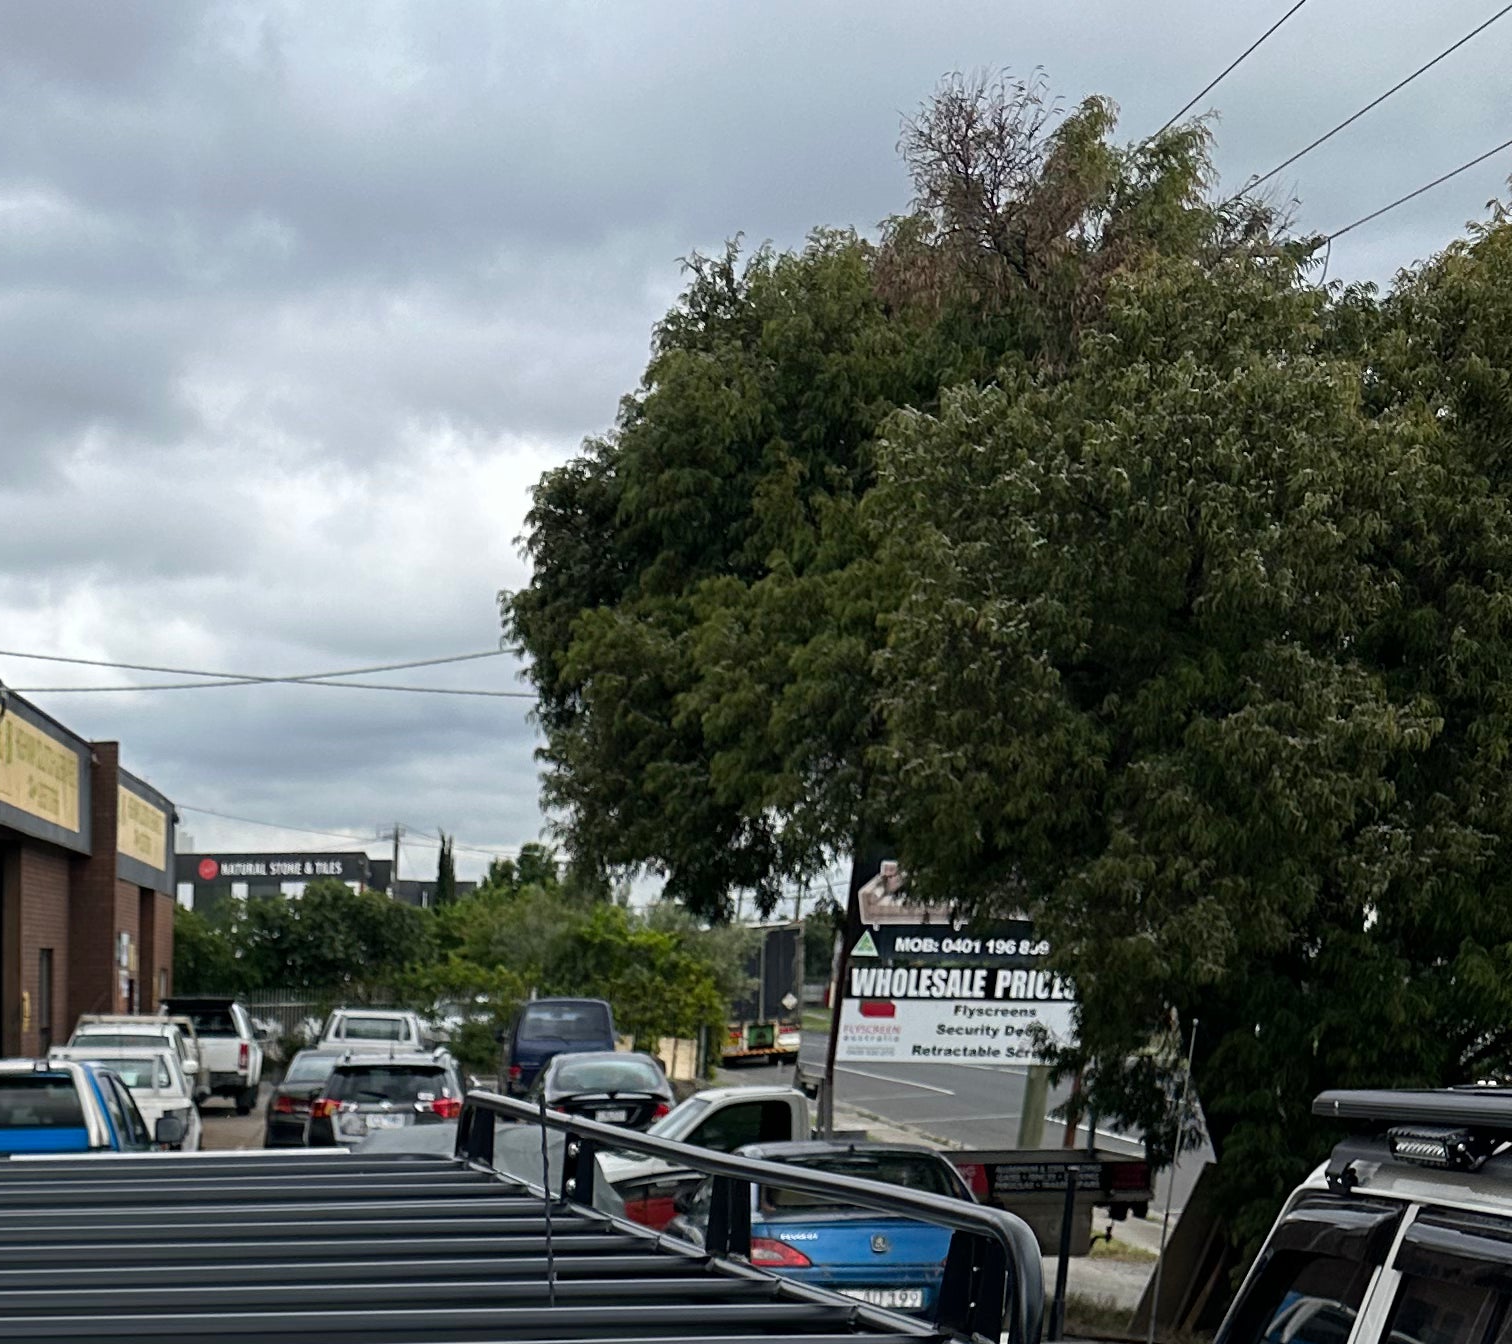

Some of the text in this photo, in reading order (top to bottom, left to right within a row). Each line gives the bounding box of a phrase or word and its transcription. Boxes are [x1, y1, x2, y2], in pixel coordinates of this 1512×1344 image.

[894, 937, 939, 954] MOB:
[941, 938, 981, 954] 0401
[986, 938, 1016, 955] 196
[850, 967, 987, 998] WHOLESALE
[953, 1004, 1037, 1019] Flyscreens
[936, 1024, 1000, 1039] Security
[911, 1044, 1001, 1057] Retractable
